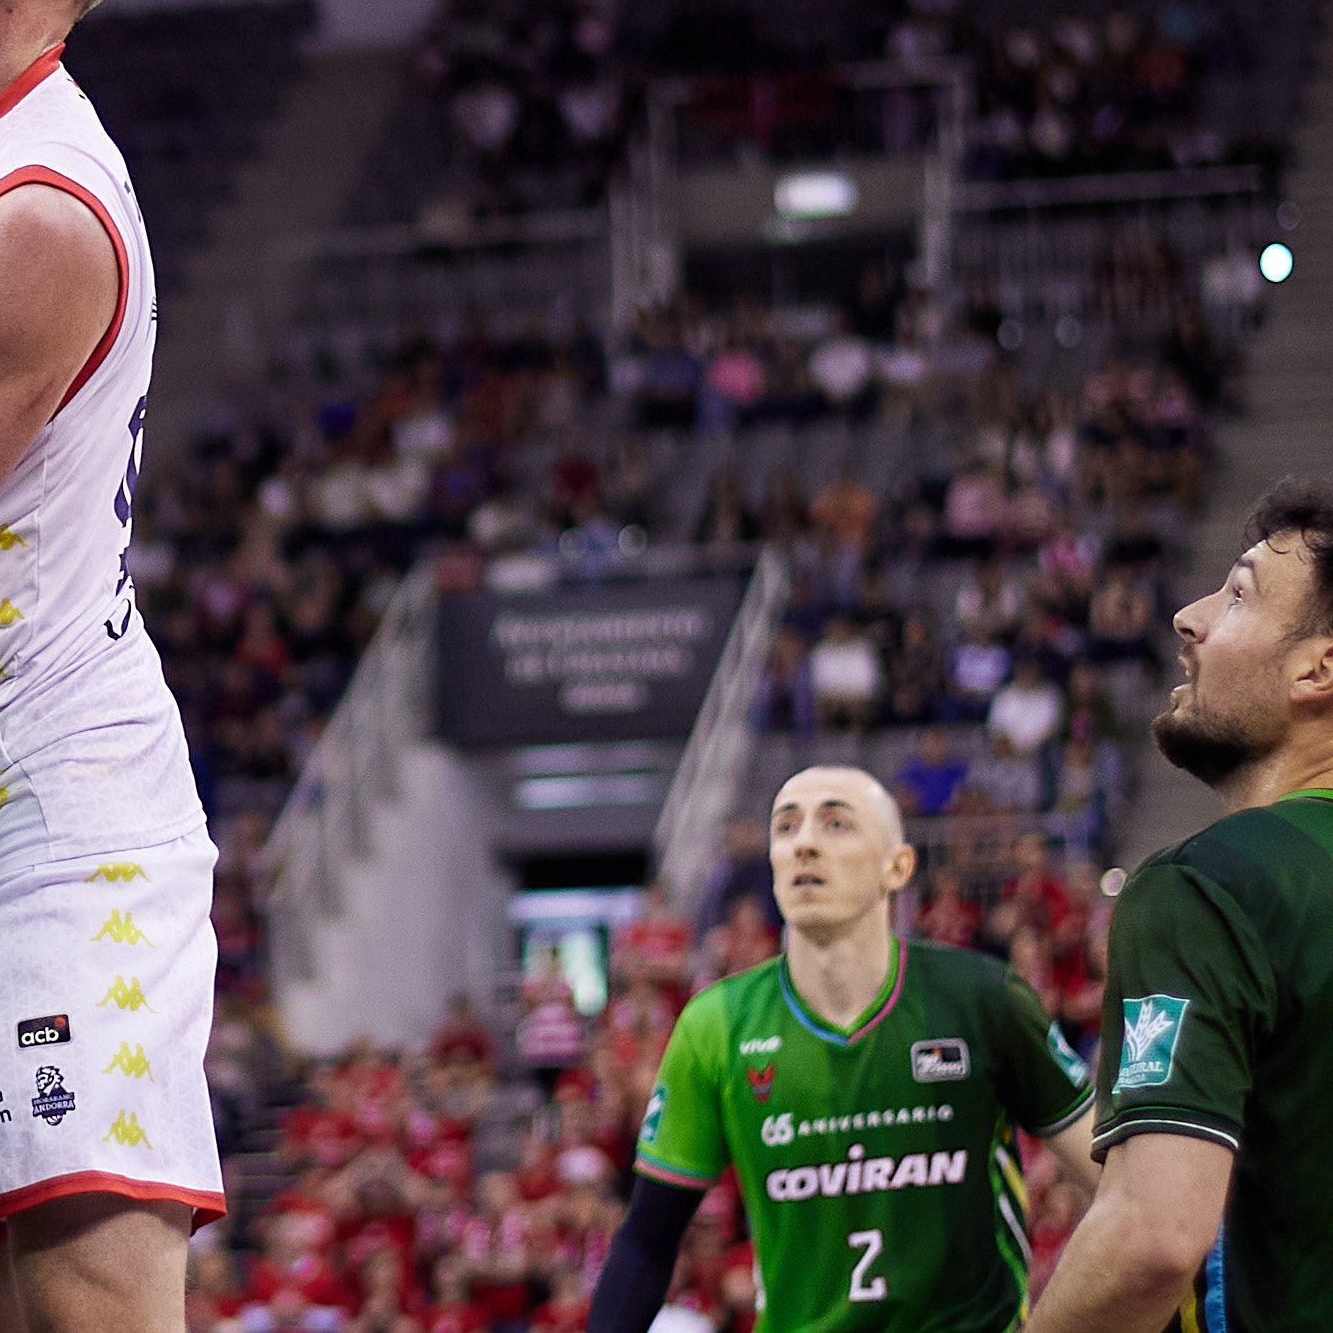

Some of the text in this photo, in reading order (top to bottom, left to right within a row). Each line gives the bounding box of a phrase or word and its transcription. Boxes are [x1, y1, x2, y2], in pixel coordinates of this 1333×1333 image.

[21, 1026, 60, 1046] acb
[33, 1099, 75, 1115] ANDORRA
[847, 1228, 889, 1304] 2
